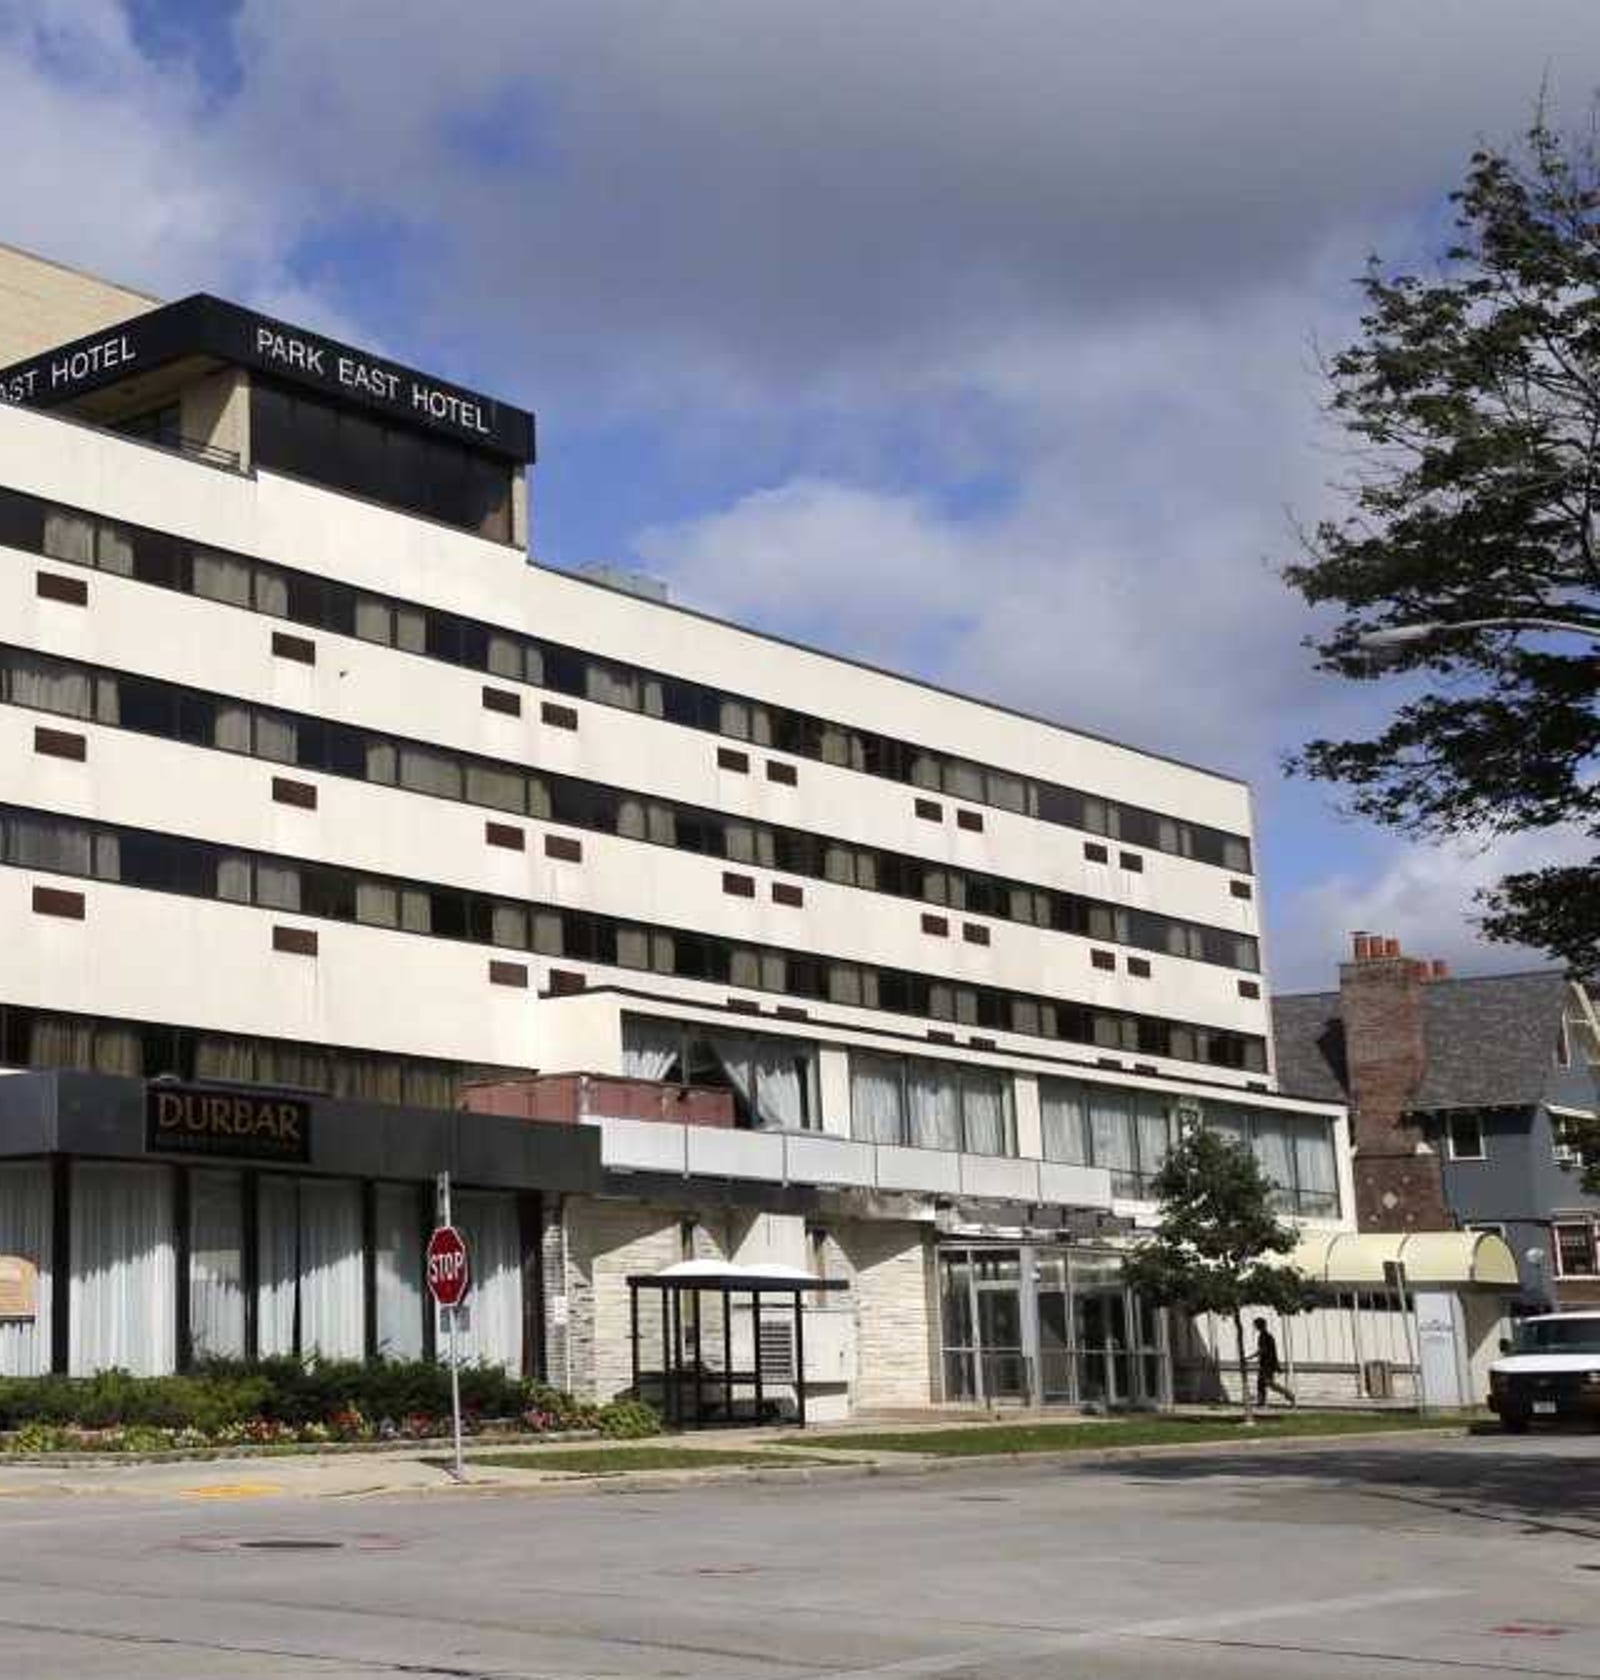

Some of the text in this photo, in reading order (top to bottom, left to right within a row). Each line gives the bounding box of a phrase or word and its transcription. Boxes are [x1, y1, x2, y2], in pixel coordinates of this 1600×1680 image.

[51, 335, 136, 389] HOTEL
[256, 328, 490, 433] PARK EAST HOTEL
[158, 1093, 302, 1139] DURBAR
[431, 1251, 463, 1284] STOP
